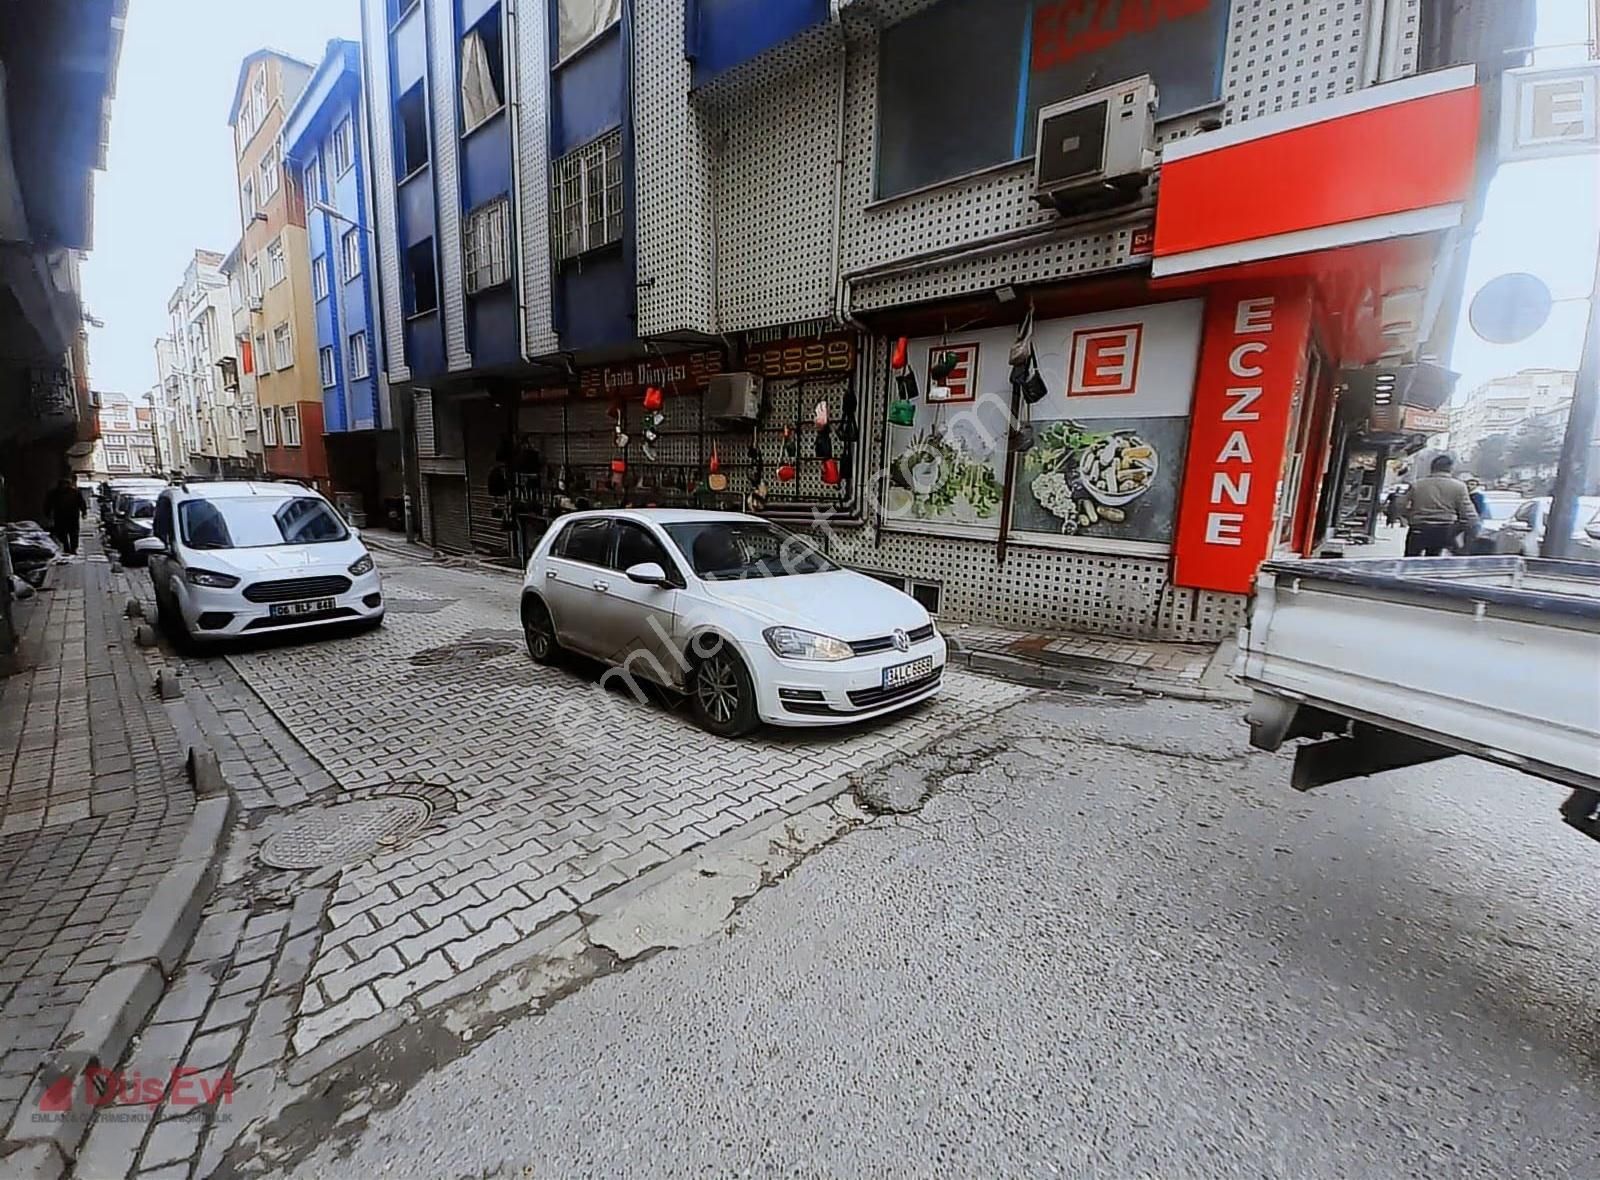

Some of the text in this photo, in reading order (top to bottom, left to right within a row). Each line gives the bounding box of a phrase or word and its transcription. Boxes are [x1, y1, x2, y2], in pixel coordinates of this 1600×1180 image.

[1032, 0, 1212, 72] ECZA
[1533, 81, 1584, 137] E
[604, 363, 686, 392] Çanta Dünyası
[1082, 335, 1127, 387] E
[1204, 296, 1274, 545] ECZANE
